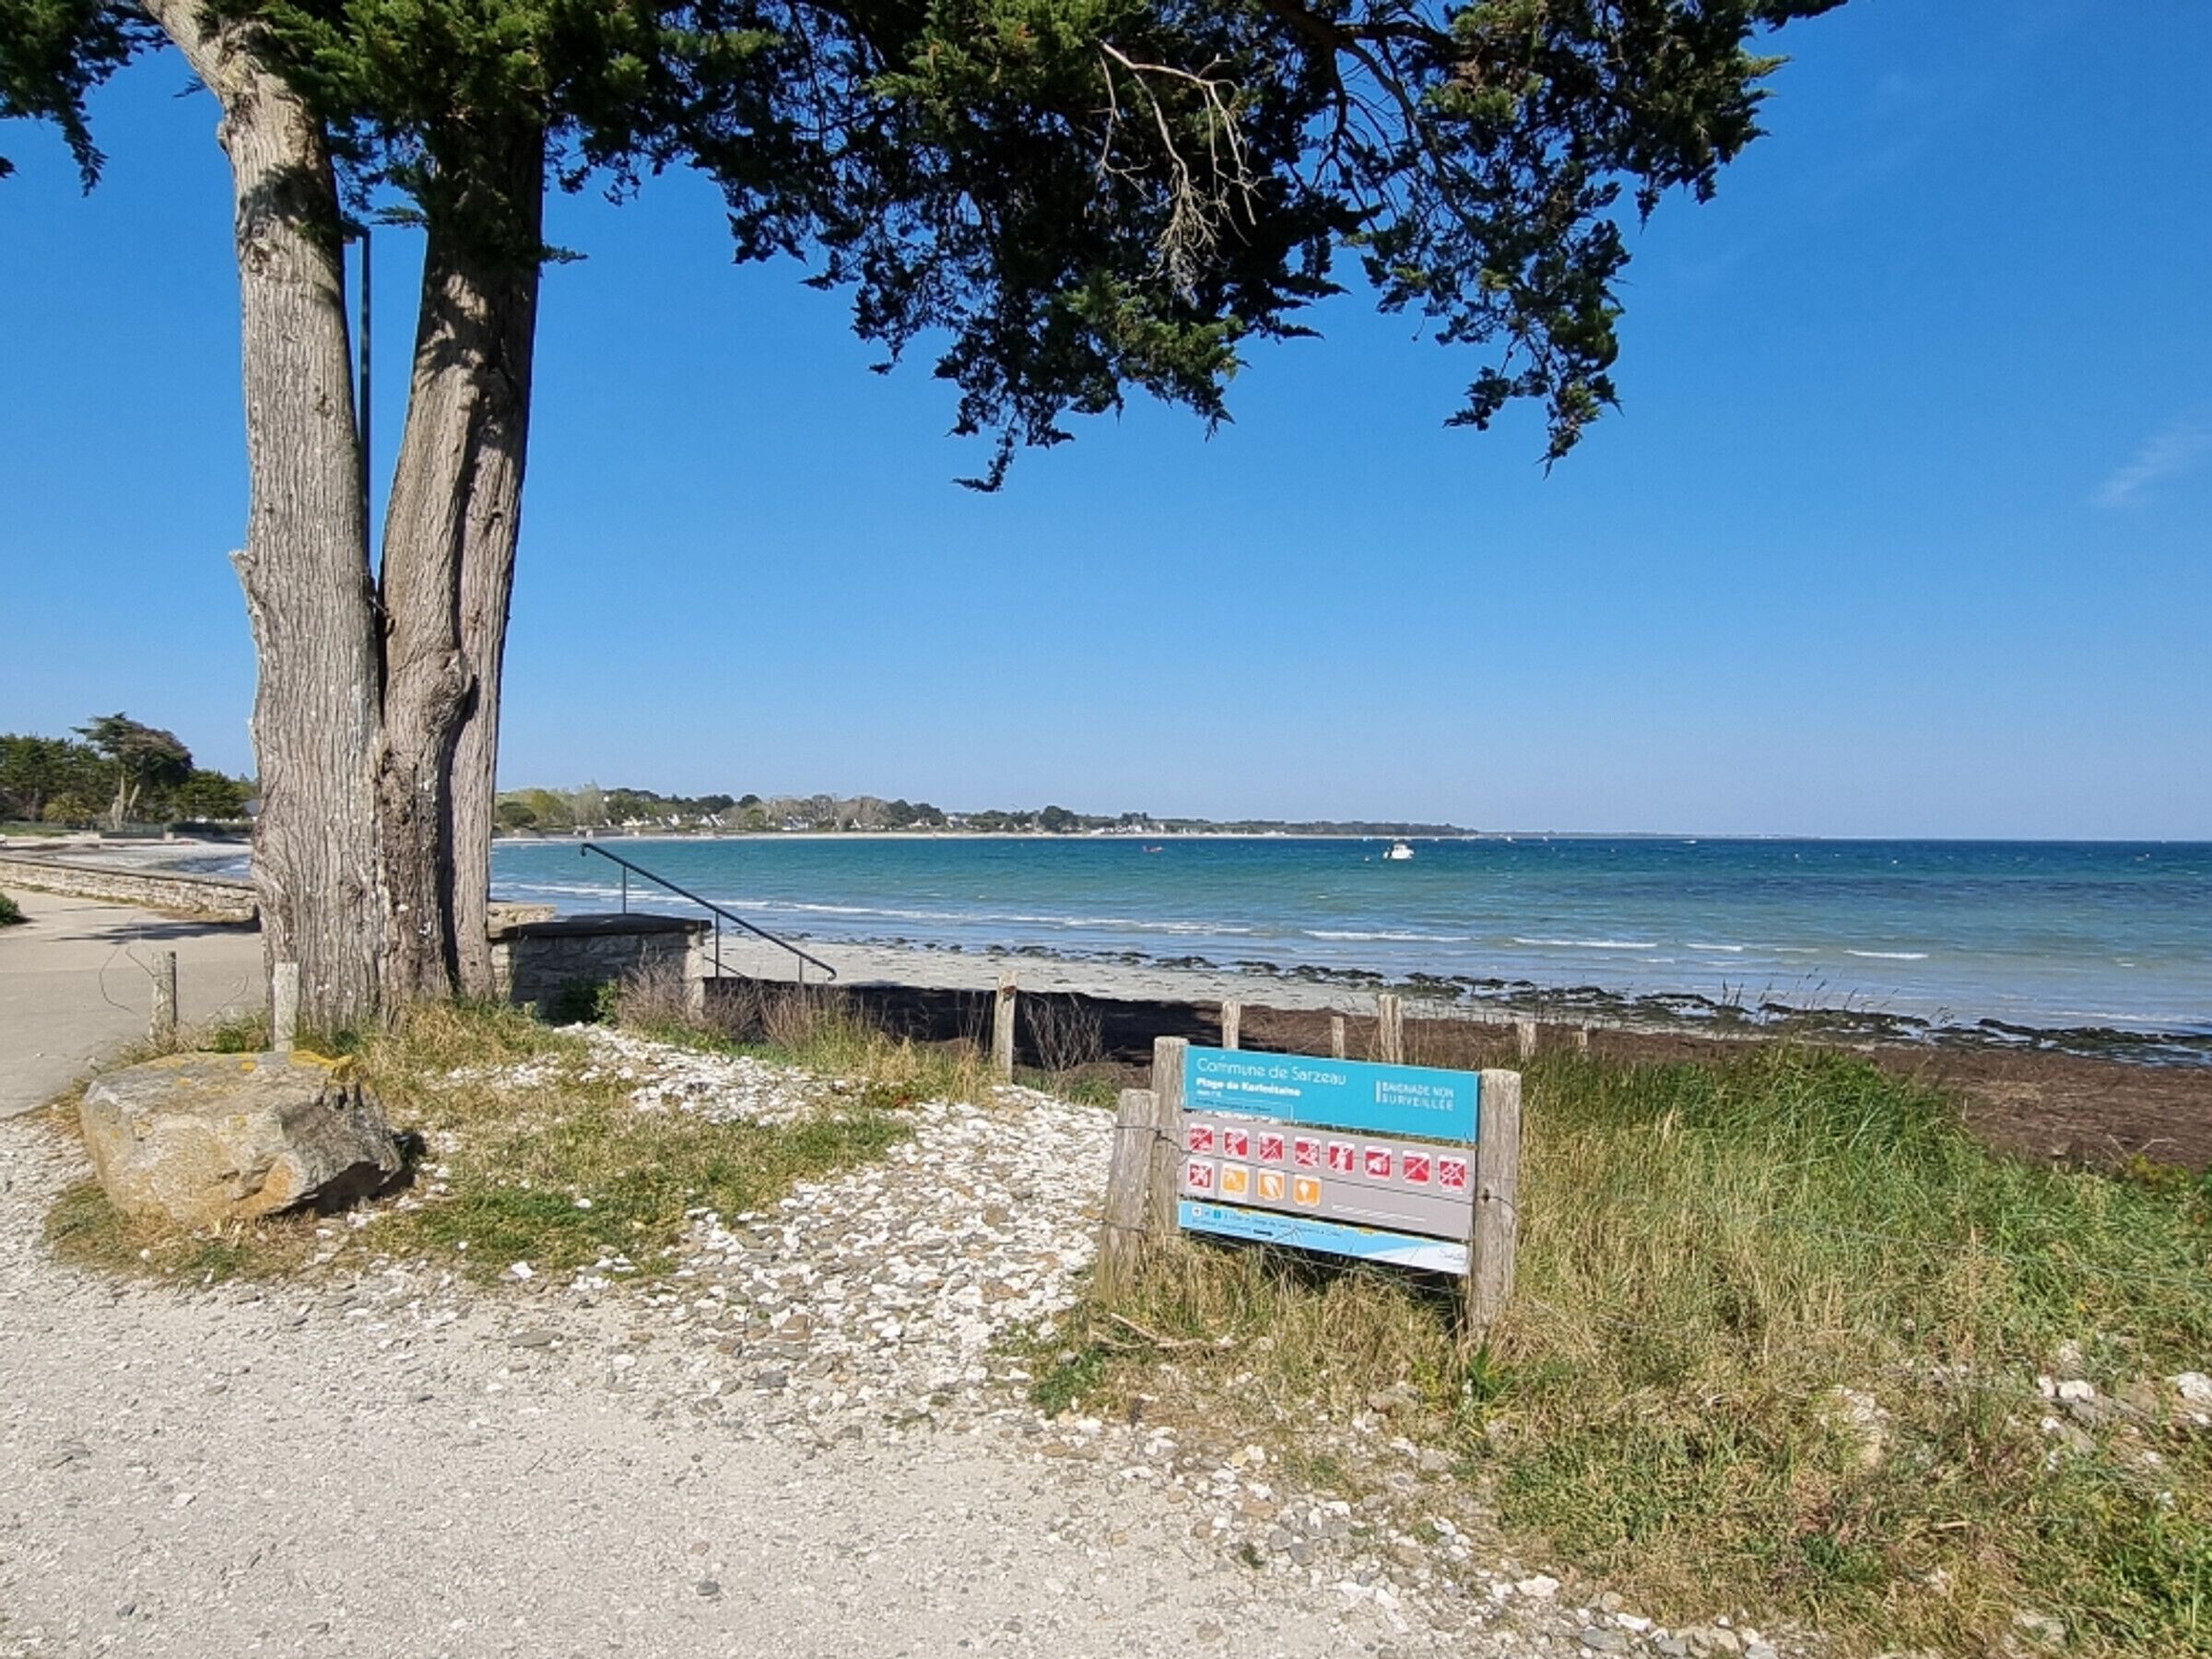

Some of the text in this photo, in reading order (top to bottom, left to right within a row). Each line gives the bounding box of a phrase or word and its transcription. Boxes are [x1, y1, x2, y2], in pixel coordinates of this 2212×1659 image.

[1196, 1057, 1347, 1086] Commune de Sarzeau
[1196, 1077, 1224, 1089] Plage
[1226, 1081, 1240, 1090] de
[1382, 1081, 1454, 1098] BAIGNADE NON
